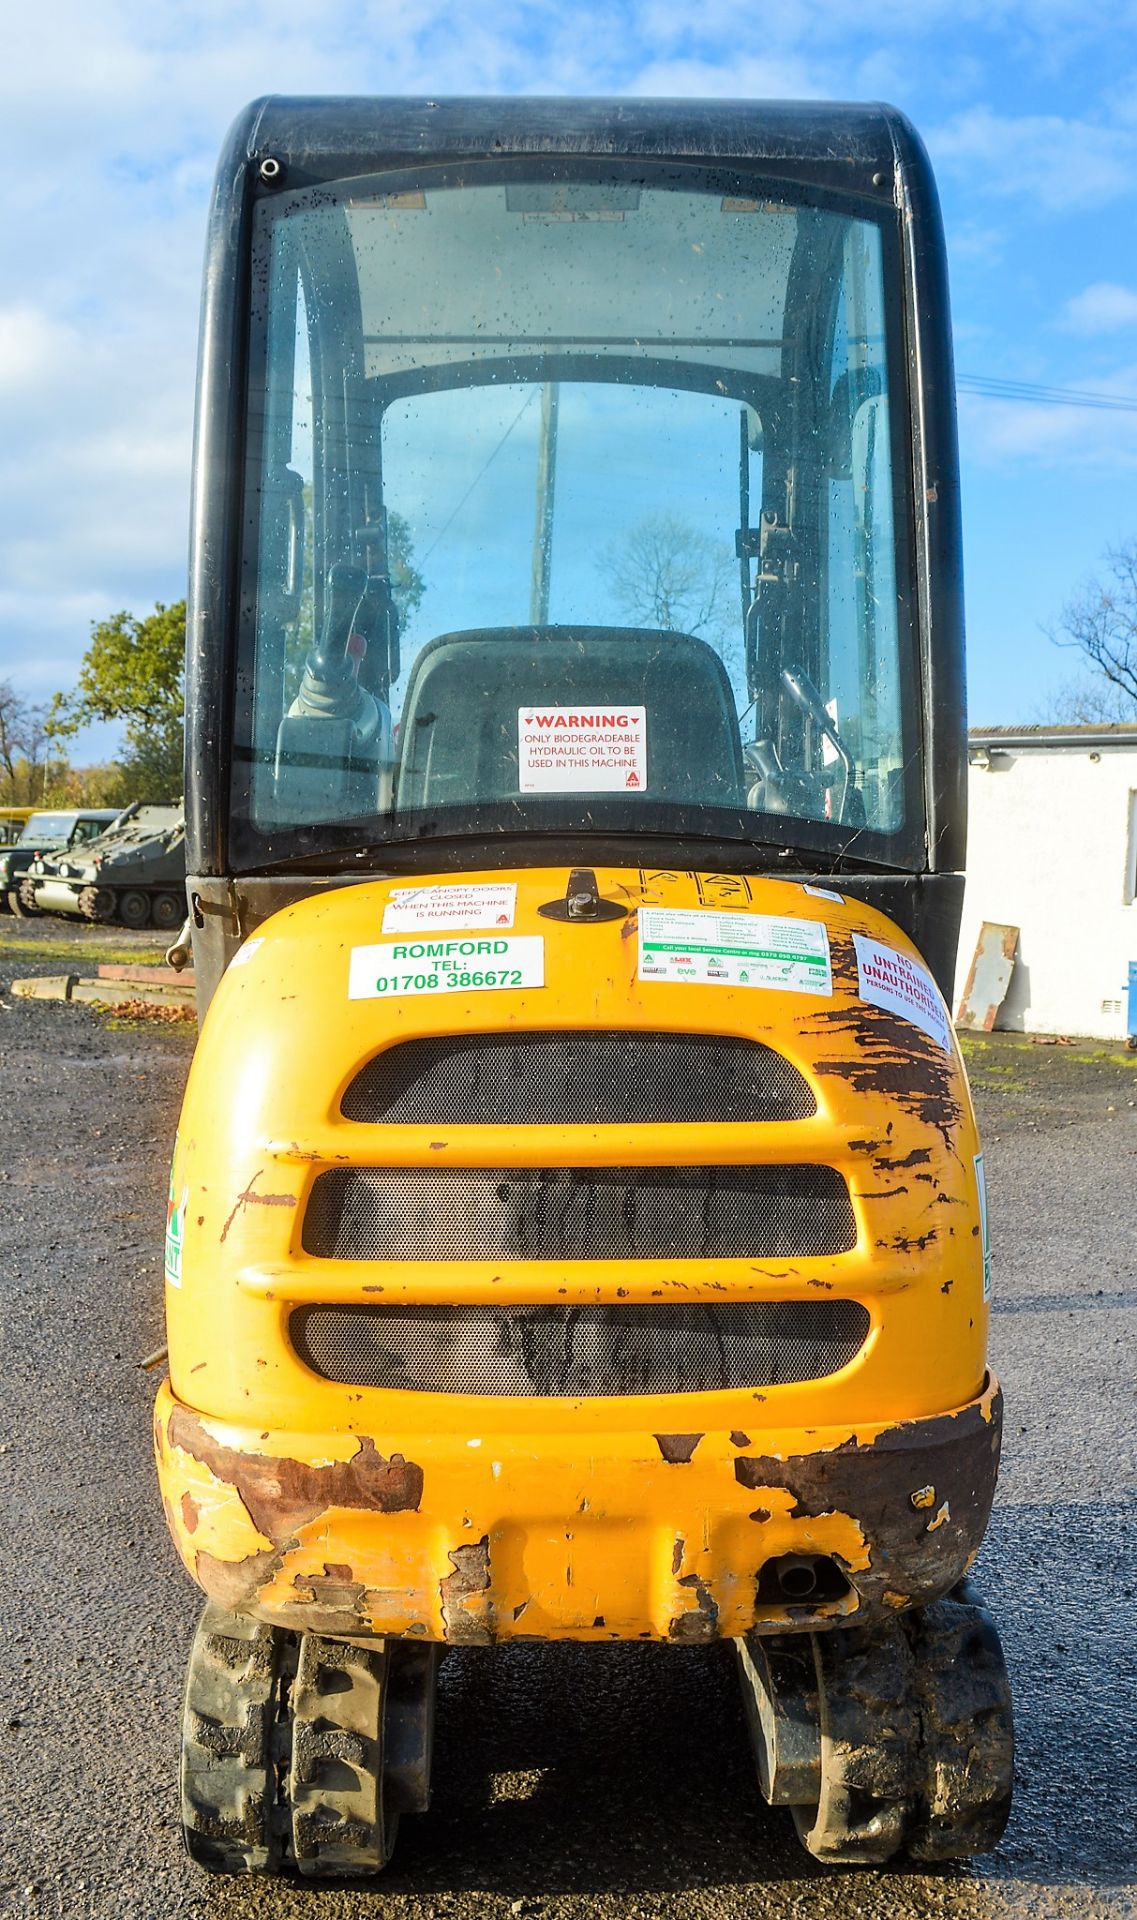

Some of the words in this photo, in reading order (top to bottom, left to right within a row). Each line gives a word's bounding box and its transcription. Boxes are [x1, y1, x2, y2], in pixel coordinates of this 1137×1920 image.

[536, 715, 629, 728] WARNING
[524, 735, 551, 743] ONLY
[554, 734, 640, 743] BIODEGRADEABLE
[529, 747, 587, 756] HYDRAULIC
[589, 747, 606, 755] OIL
[607, 747, 621, 755] TO
[624, 746, 636, 755] BE
[528, 760, 553, 768] USED
[556, 760, 567, 768] IN
[592, 759, 638, 767] MACHINE
[627, 771, 639, 782] A
[422, 887, 469, 895] CANOPY
[392, 902, 428, 911] WHEN
[457, 899, 508, 907] MACHINE
[428, 909, 482, 917] RUNNING
[393, 941, 509, 959] ROMFORD
[431, 961, 467, 971] TEL:
[896, 953, 912, 970] NO
[677, 967, 697, 976] eve
[873, 954, 935, 999] UNTRAINED
[376, 974, 439, 992] 01708
[446, 970, 522, 987] 386672
[862, 963, 945, 1022] UNAUTHORISED
[866, 979, 894, 994] PERSONS
[894, 989, 903, 998] TO
